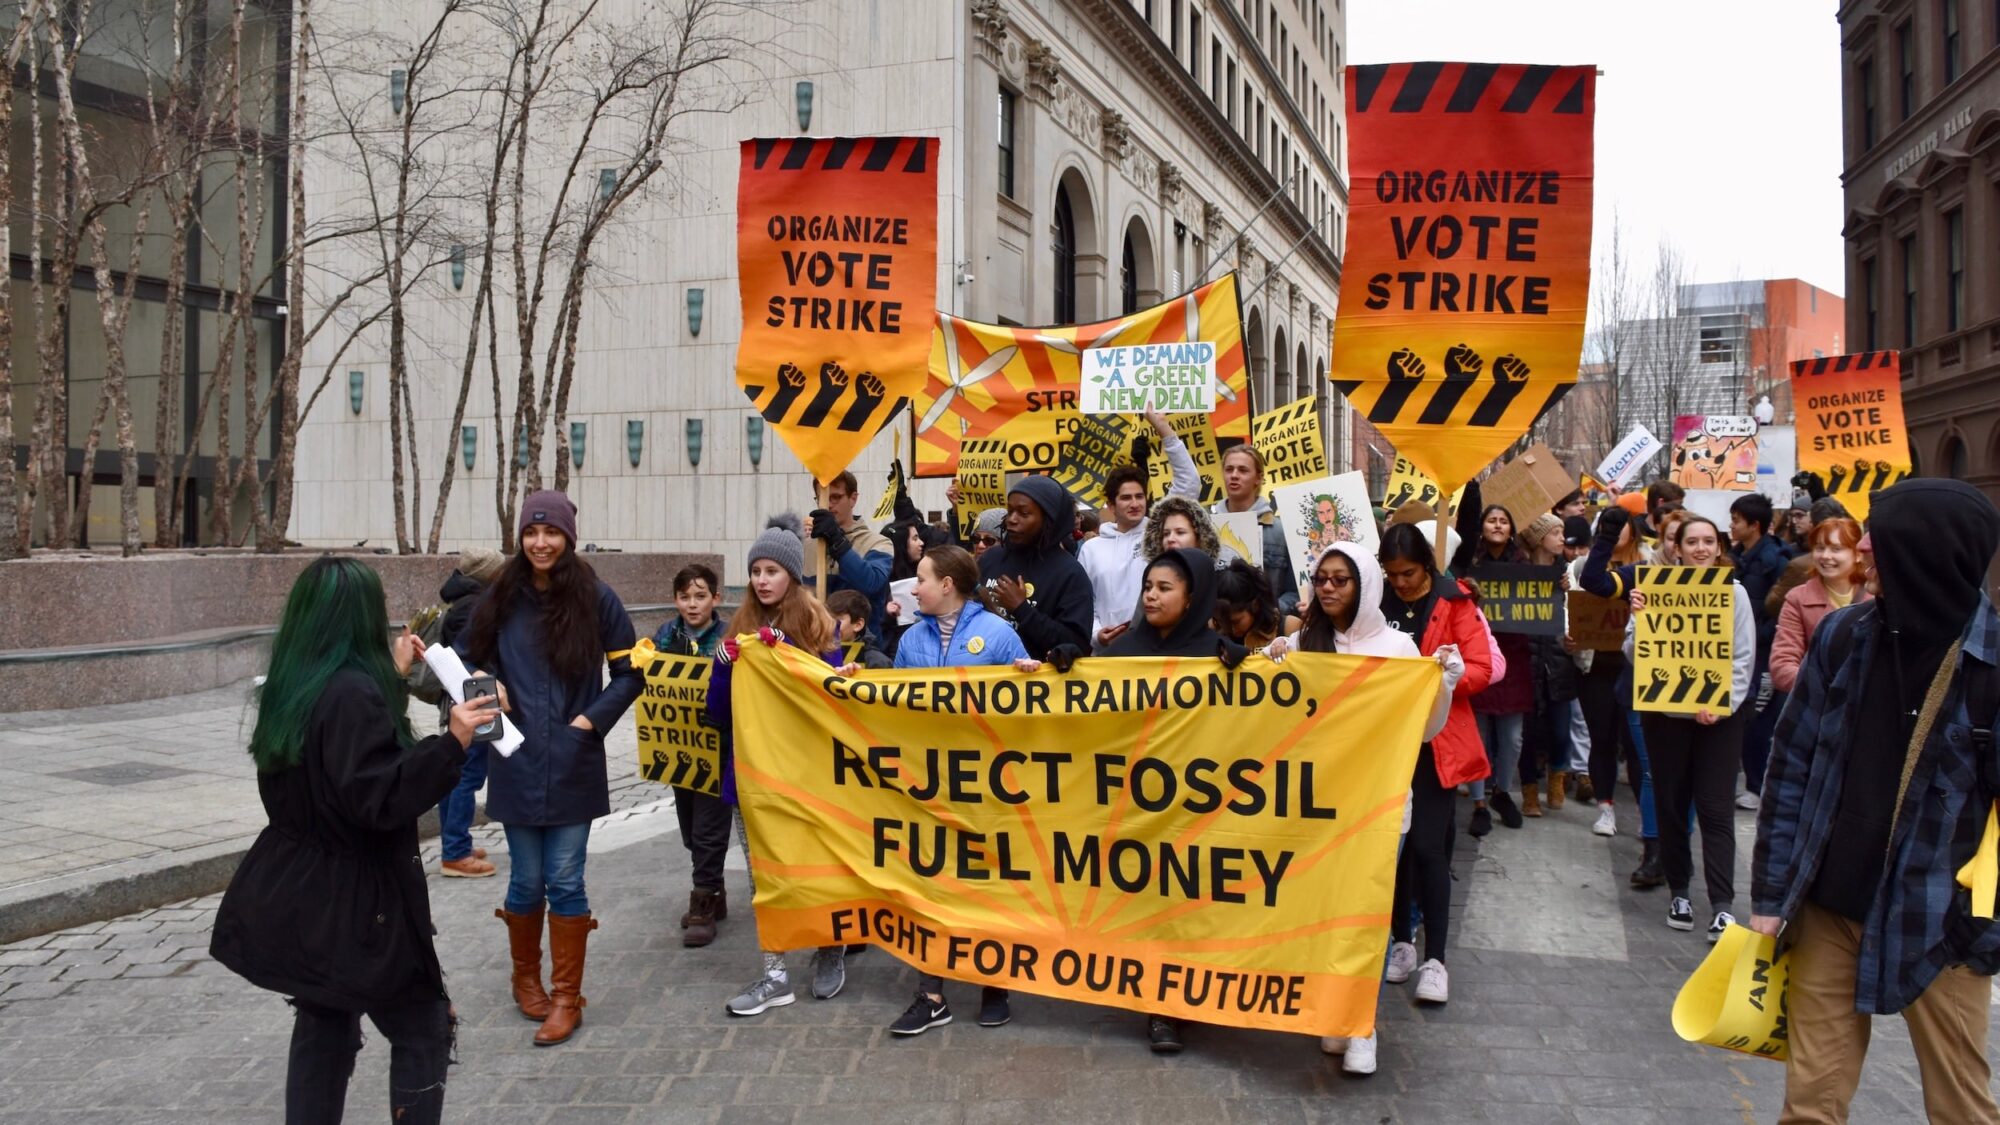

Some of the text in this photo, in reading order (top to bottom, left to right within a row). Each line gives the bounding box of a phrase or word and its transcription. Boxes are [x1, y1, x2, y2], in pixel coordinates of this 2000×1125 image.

[1943, 106, 1973, 141] BANK
[1376, 169, 1560, 205] ORGANIZE
[767, 214, 908, 245] ORGANIZE
[1390, 215, 1539, 262] VOTE
[781, 250, 893, 290] VOTE
[1364, 271, 1551, 315] STRIKE
[766, 295, 902, 334] STRIKE
[1096, 343, 1213, 368] WE DEMAND
[1106, 365, 1206, 388] A GREEN
[1026, 390, 1080, 412] STR
[1099, 386, 1208, 411] NEW DEAL
[1807, 389, 1887, 410] ORGANIZE
[1056, 418, 1080, 435] FO
[1141, 413, 1206, 437] ORANIZE
[1816, 407, 1882, 430] VOTE
[1081, 417, 1124, 447] ORGANI
[1150, 431, 1205, 457] VTE
[1254, 419, 1316, 450] ORGANIZE
[1813, 429, 1892, 451] STRIKE
[959, 458, 1003, 470] ORGANIZE
[1063, 444, 1111, 477] STRIK
[1149, 450, 1216, 477] STKE
[1261, 436, 1314, 466] VOTE
[1606, 436, 1650, 479] Bernie
[960, 473, 998, 489] VOTE
[1263, 455, 1325, 485] TRIKE
[958, 492, 1006, 506] STRIKE
[1481, 581, 1554, 599] EEN NEW
[1483, 603, 1554, 621] AL NOW
[1645, 613, 1721, 635] VOTE
[1638, 640, 1730, 660] STRIKE
[645, 683, 707, 703] RGANIZ
[823, 671, 1318, 718] GOVERNOR RAIMONDO,
[638, 725, 717, 751] STRIKE
[833, 737, 1337, 819] REJECT FOSSIL
[874, 817, 1294, 907] FUEL MONEY
[830, 907, 1305, 1016] FIGHT FOR OUR FUTURE
